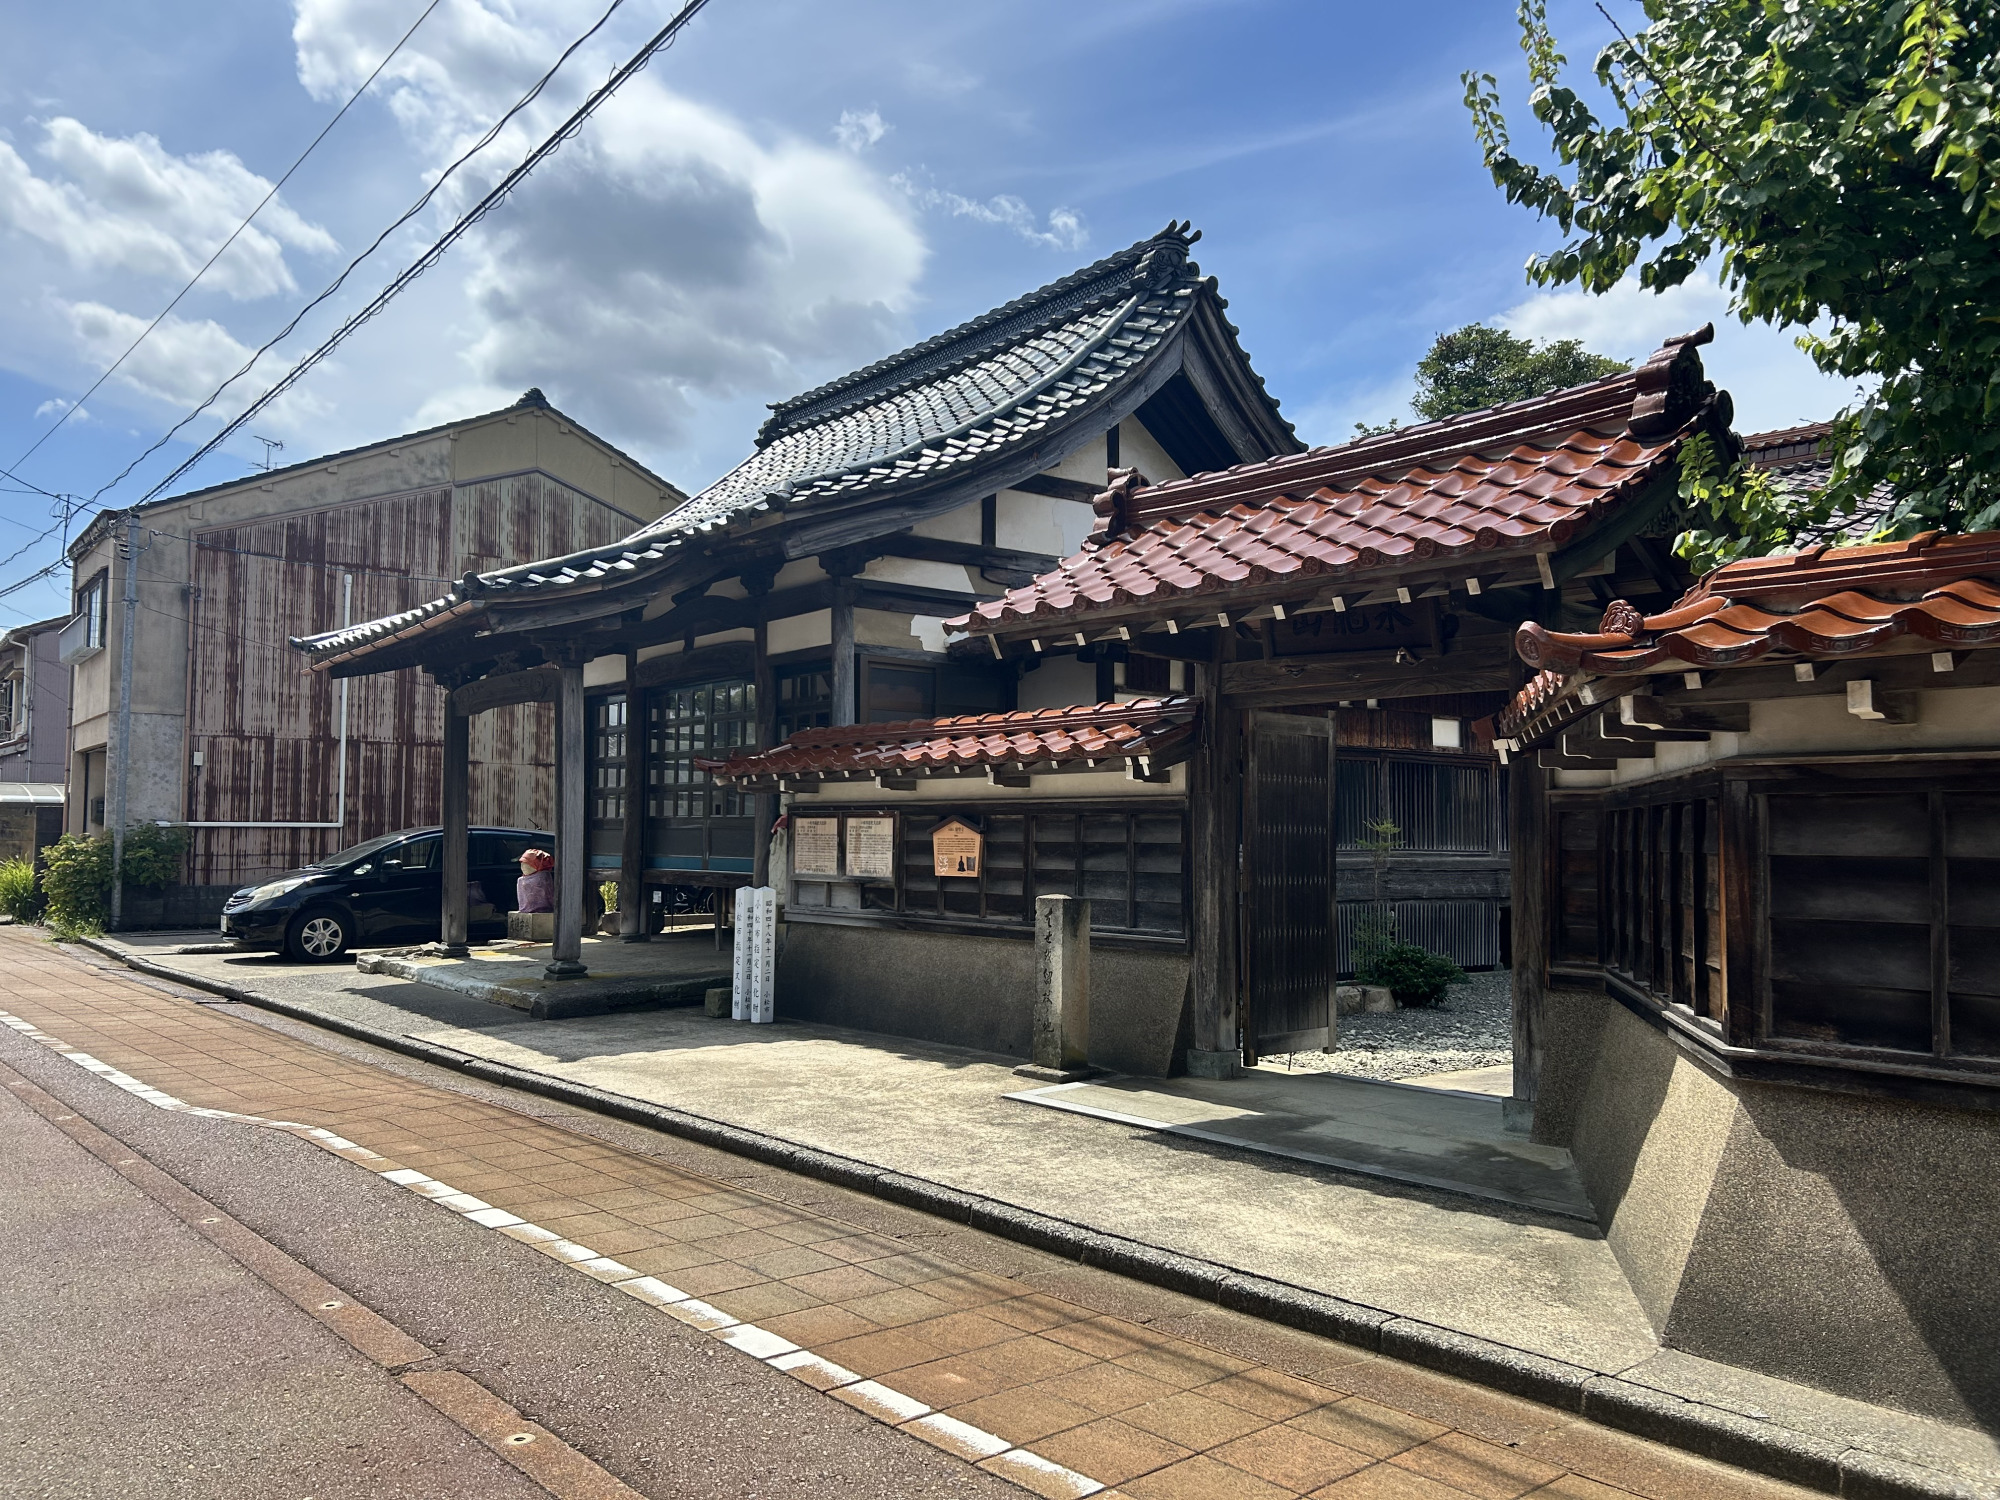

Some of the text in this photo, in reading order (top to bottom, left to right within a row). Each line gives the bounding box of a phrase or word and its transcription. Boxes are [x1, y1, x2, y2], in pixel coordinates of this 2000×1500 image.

[753, 899, 761, 1013] 小松市指定文化財
